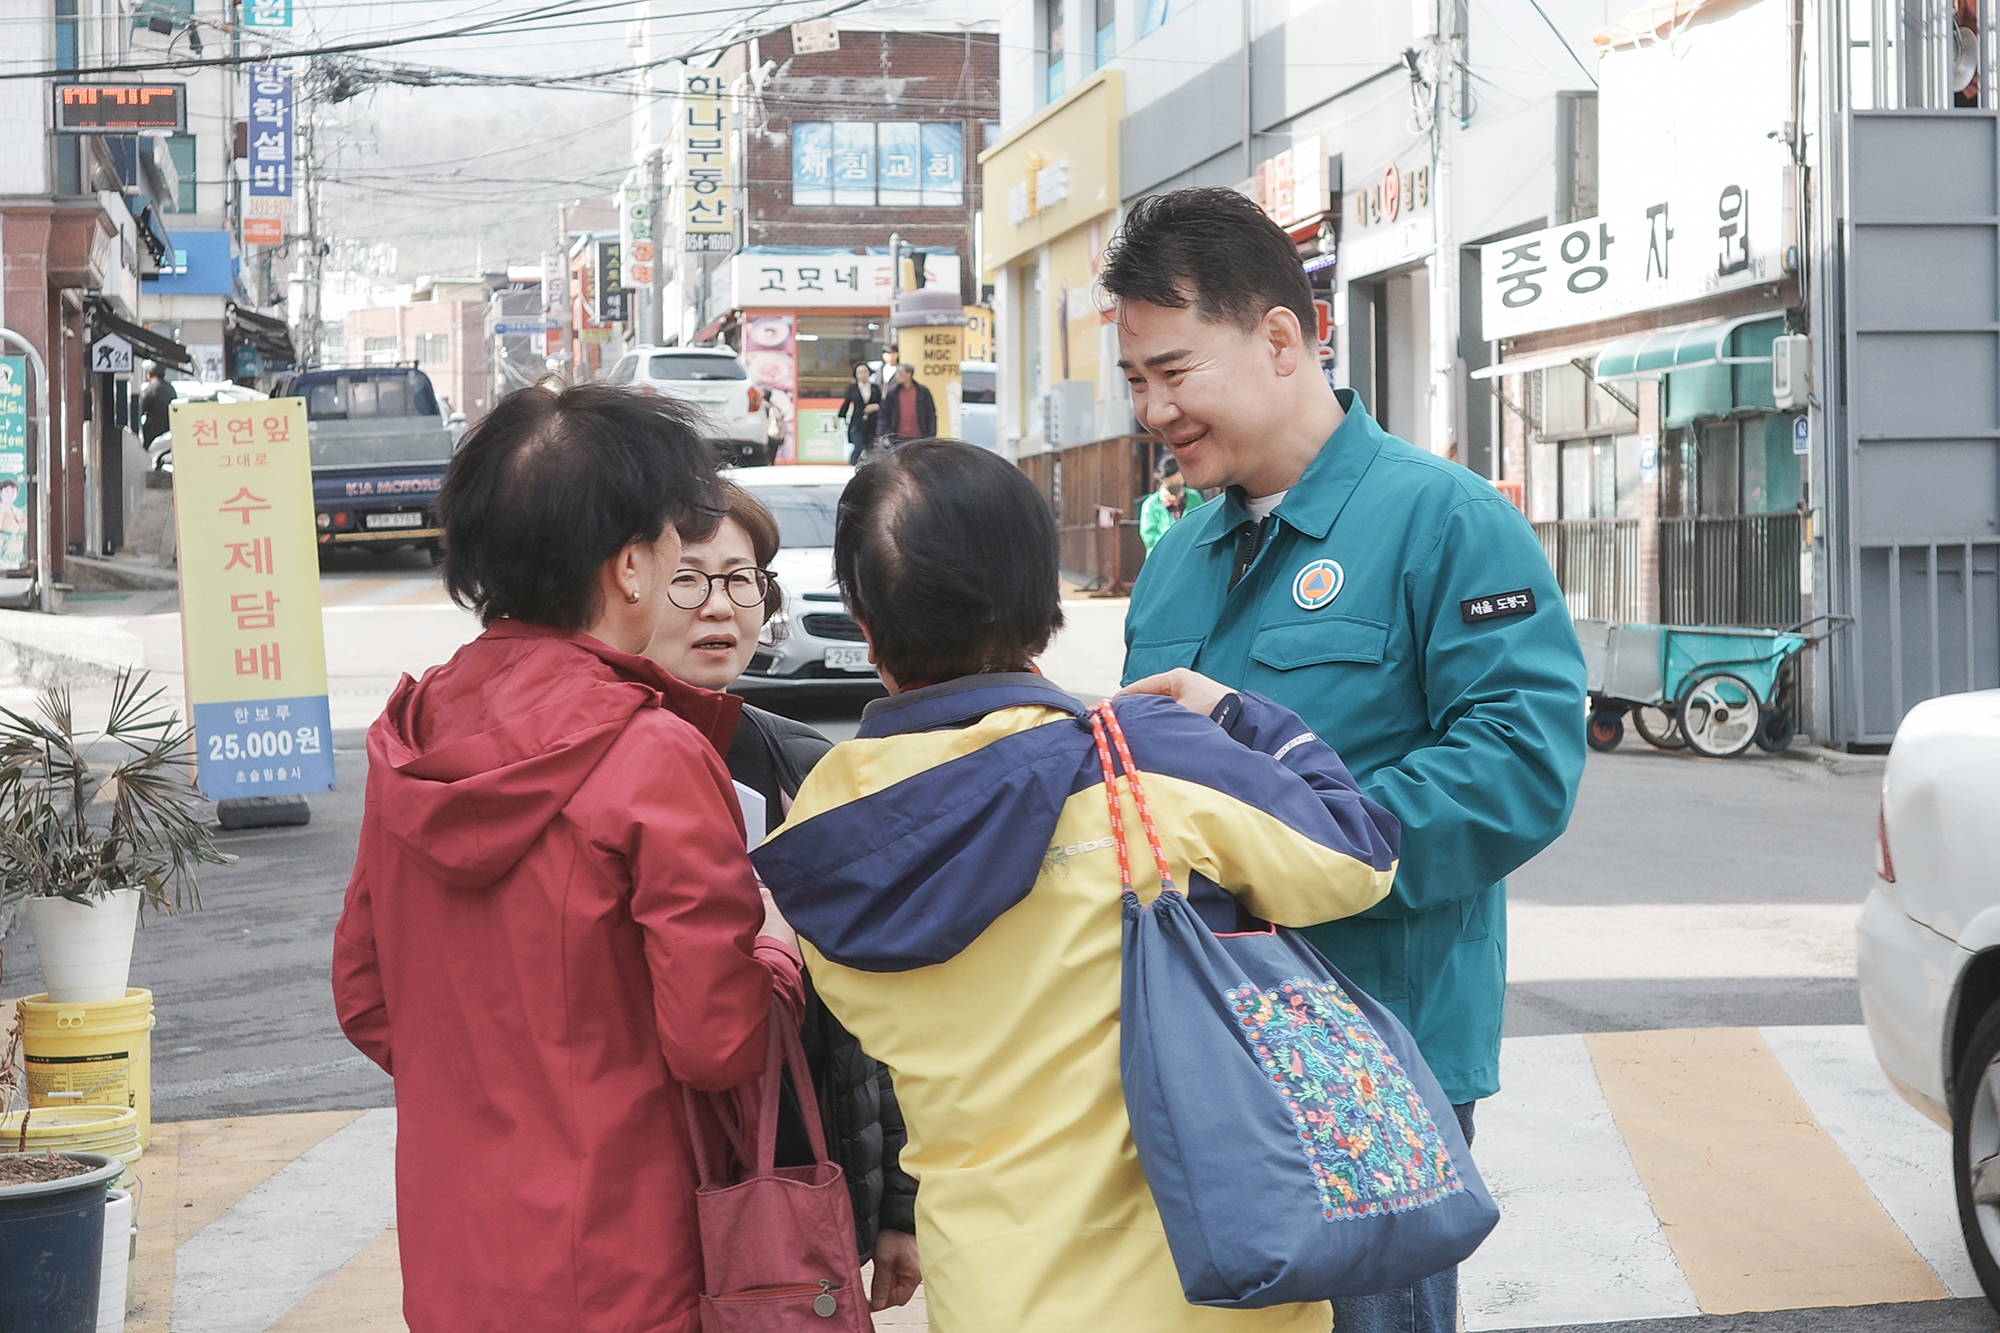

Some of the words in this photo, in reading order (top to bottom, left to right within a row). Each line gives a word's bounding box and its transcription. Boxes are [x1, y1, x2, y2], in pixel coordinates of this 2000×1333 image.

[252, 65, 290, 193] 방학설비
[687, 75, 727, 224] 하나부동산
[759, 266, 858, 293] 고모네
[114, 350, 129, 362] 24
[191, 415, 291, 447] 천연잎
[217, 452, 270, 468] 그대로
[345, 482, 373, 496] KIA
[376, 478, 442, 495] MOTORS
[218, 486, 282, 681] 수제담배
[1470, 600, 1494, 615] 서울
[1496, 594, 1529, 609] 도봉구
[233, 704, 292, 725] 한보루
[208, 726, 321, 761] 25,000원
